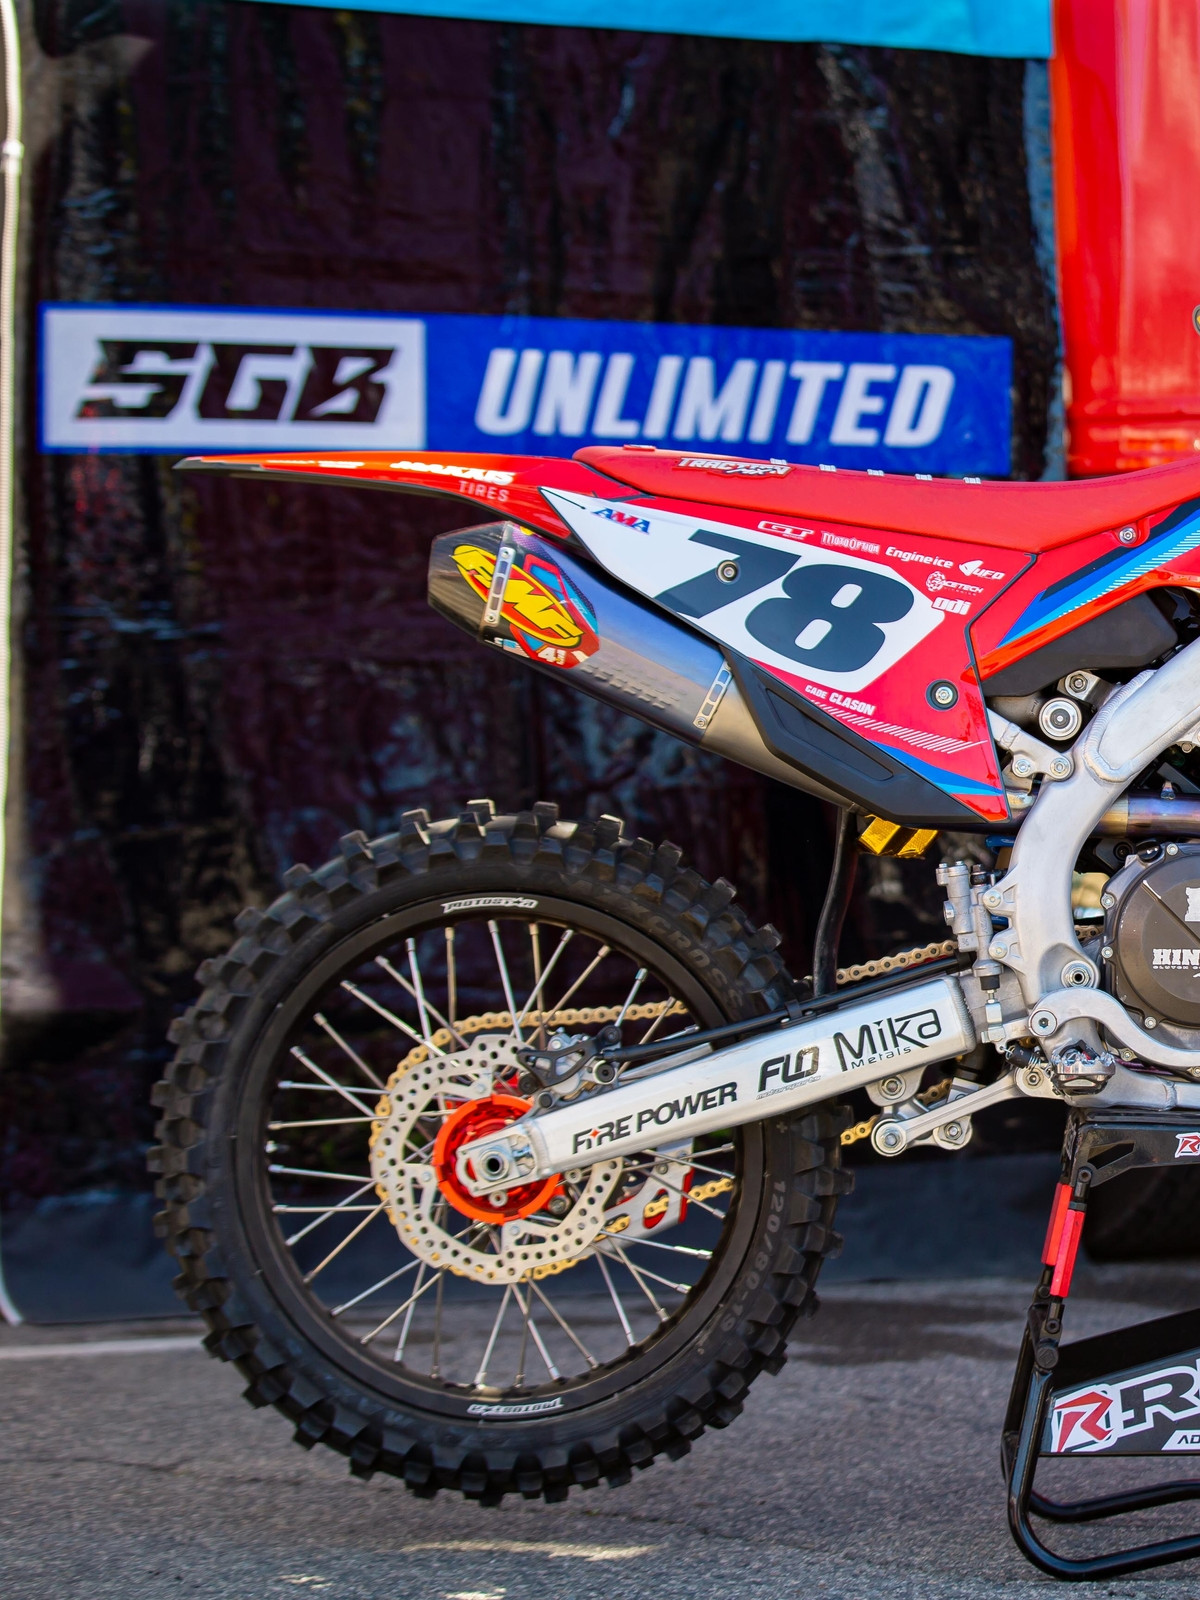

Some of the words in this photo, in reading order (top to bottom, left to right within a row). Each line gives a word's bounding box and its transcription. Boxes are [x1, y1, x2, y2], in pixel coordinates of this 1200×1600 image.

[75, 338, 397, 424] SGB
[474, 347, 956, 448] UNLIMITED
[458, 480, 510, 502] TIRES
[591, 507, 651, 535] AMA
[652, 528, 916, 673] 78
[804, 684, 829, 699] CADE
[828, 692, 877, 716] CLASON
[832, 1008, 943, 1073] Mika
[851, 1045, 913, 1071] Metals
[572, 1114, 632, 1155] FIRE
[637, 1080, 738, 1134] POWER
